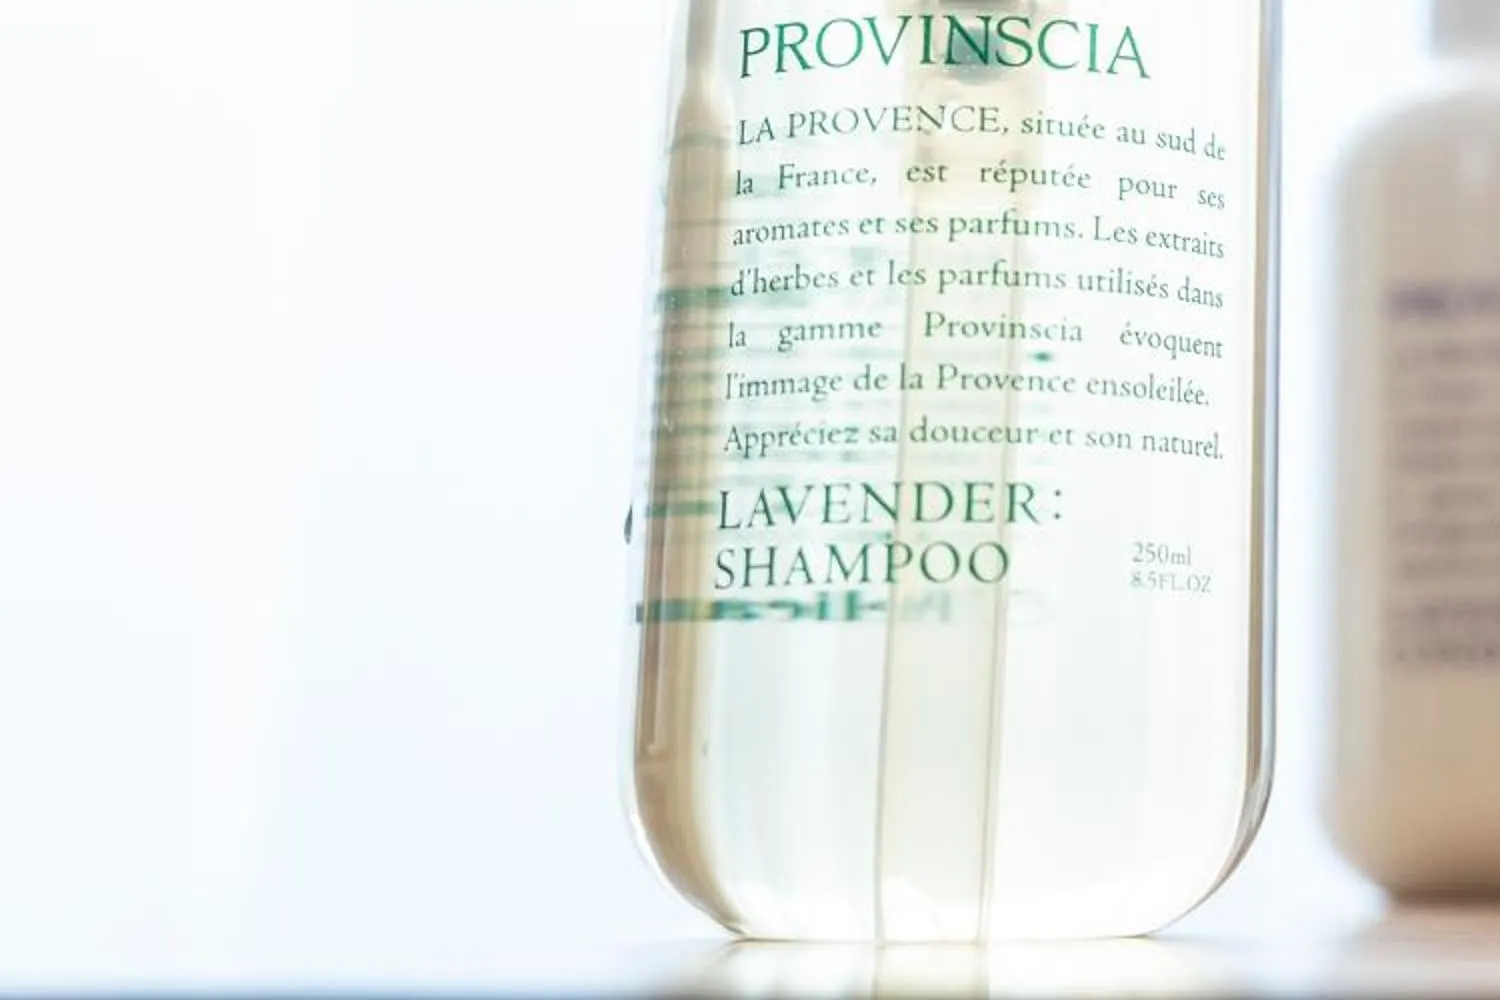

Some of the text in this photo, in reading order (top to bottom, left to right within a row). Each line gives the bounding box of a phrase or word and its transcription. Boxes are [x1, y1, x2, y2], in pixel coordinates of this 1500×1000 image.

[739, 14, 1150, 80] PROVINSCIA
[739, 104, 1226, 161] LA PROVENCE, située au sud de
[735, 160, 1225, 210] la France, est réputée pour ses
[733, 208, 1225, 259] aromates et ses parfums. Les extraits
[731, 259, 1223, 309] d'herbes et les parfums utilisés dans
[729, 311, 1223, 360] la gamme Provinscia évoquent
[726, 362, 1209, 406] l'immage de la Provence ensoleilée.
[724, 415, 1224, 460] Appréciez sa douceur et son naturel.
[719, 482, 1063, 530] LAVENDER:
[714, 540, 1010, 590] SHAMPOO
[1132, 541, 1191, 566] 250ml
